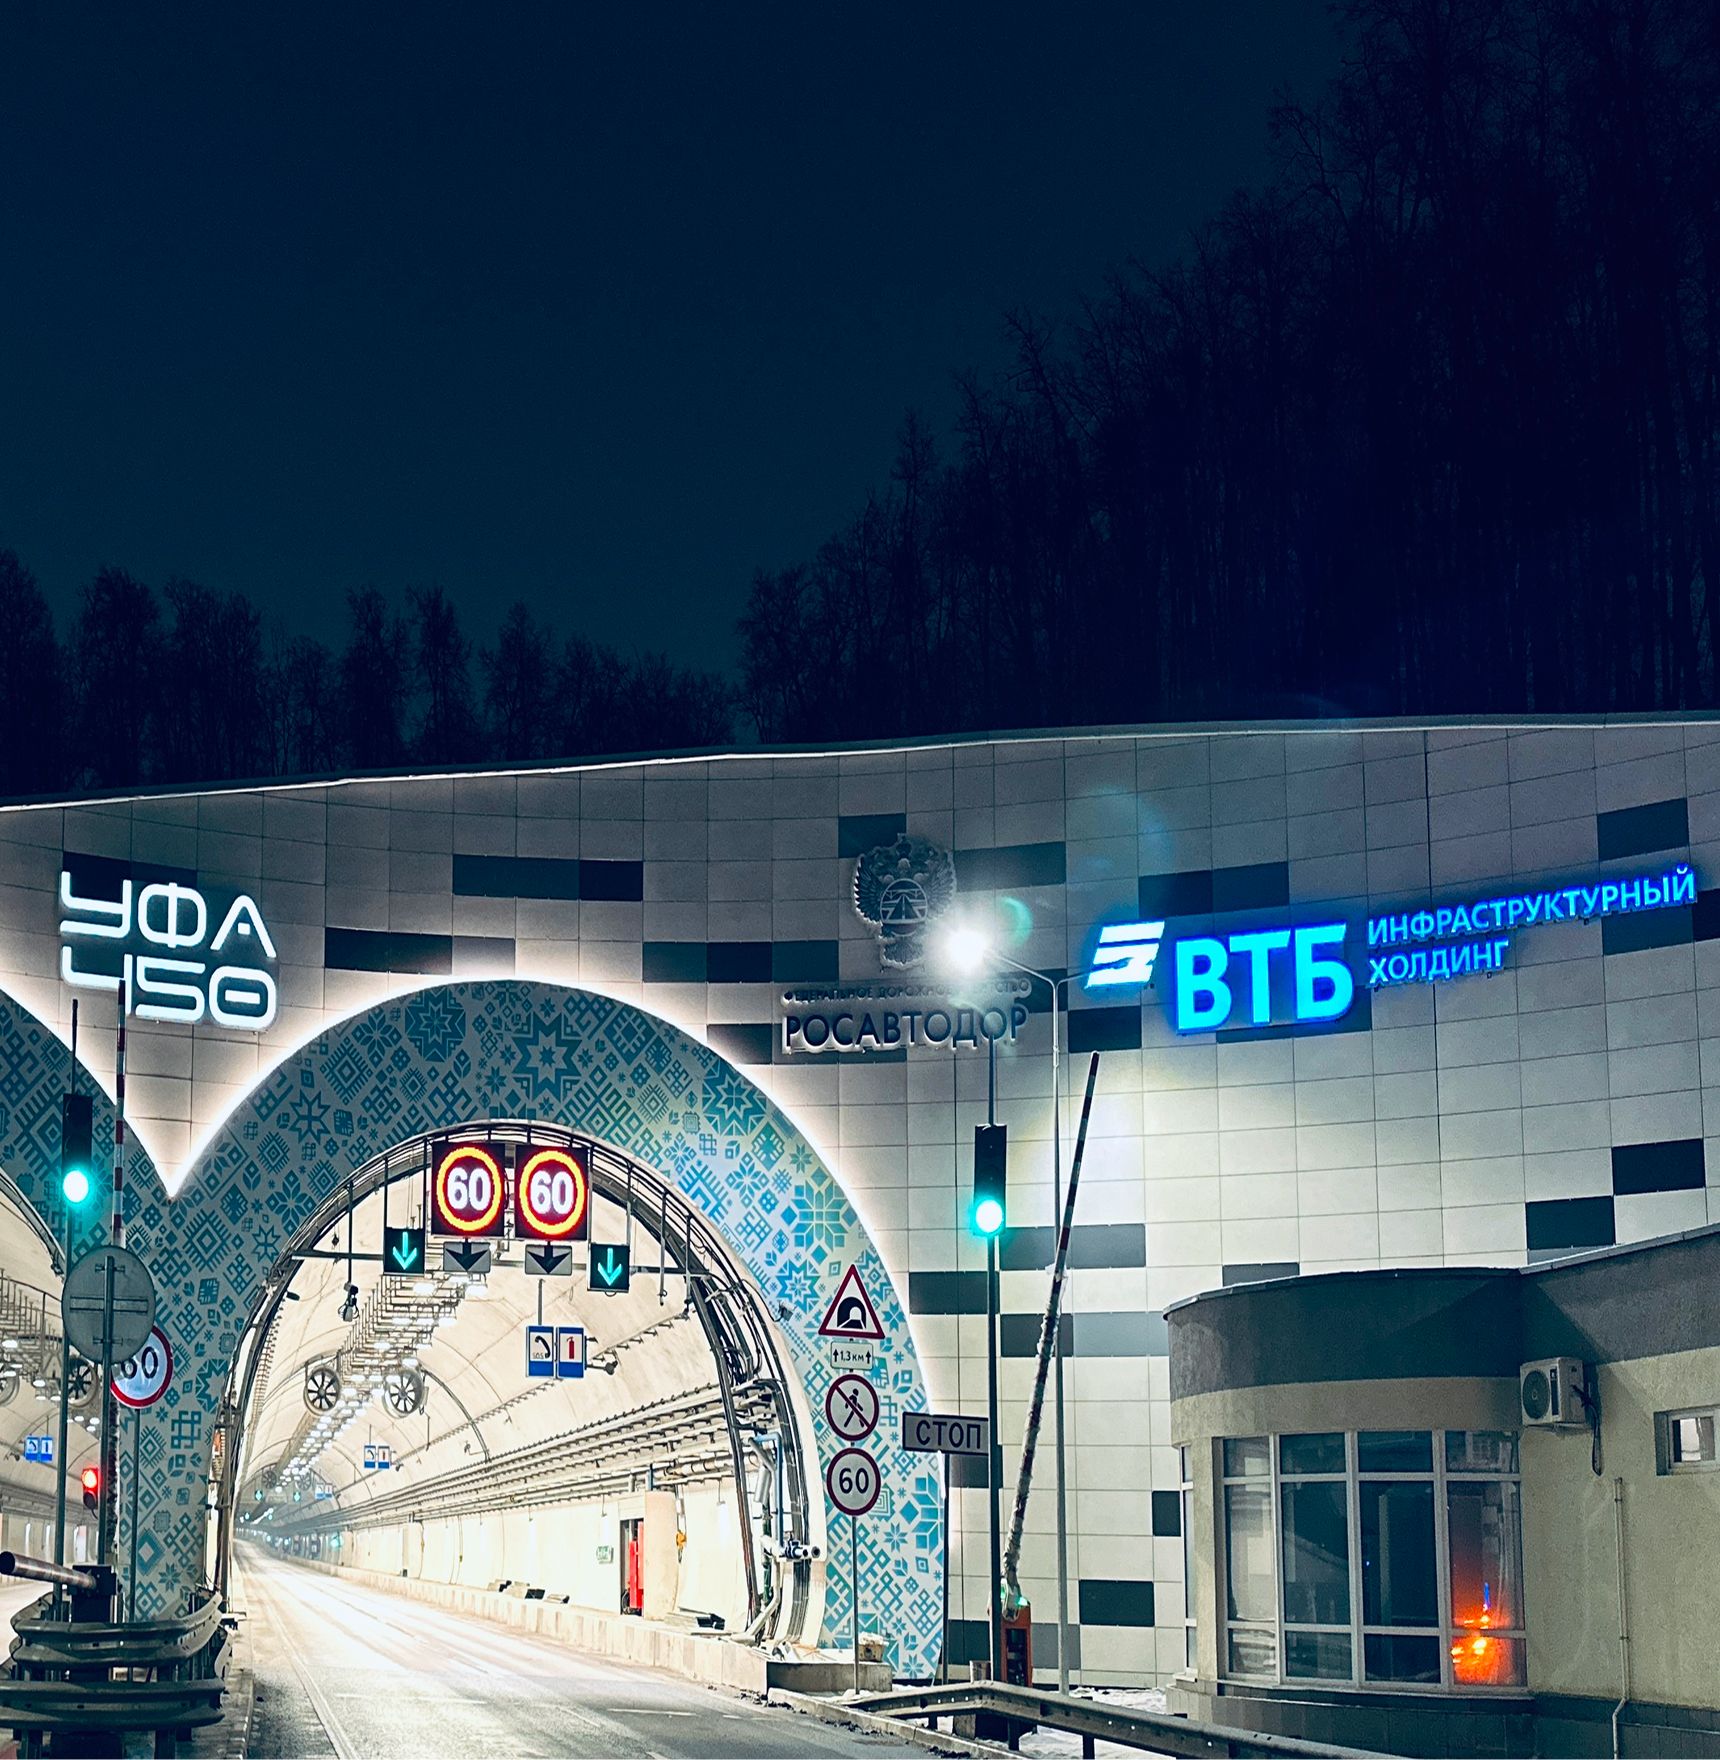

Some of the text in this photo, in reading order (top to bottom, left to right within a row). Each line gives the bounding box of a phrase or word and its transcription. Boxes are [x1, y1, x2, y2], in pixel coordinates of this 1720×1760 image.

[60, 871, 276, 958] УФА
[1367, 866, 1696, 946] ИНФРАСТРУКТУРНЫЙ
[1176, 923, 1353, 1030] ВТБ
[1369, 940, 1509, 984] ХОЛДИНГ
[785, 1003, 1028, 1050] РОСАВТОДОР
[447, 1167, 491, 1210] 60
[530, 1170, 574, 1214] 60
[916, 1420, 981, 1449] СТОП
[839, 1467, 869, 1494] 60
